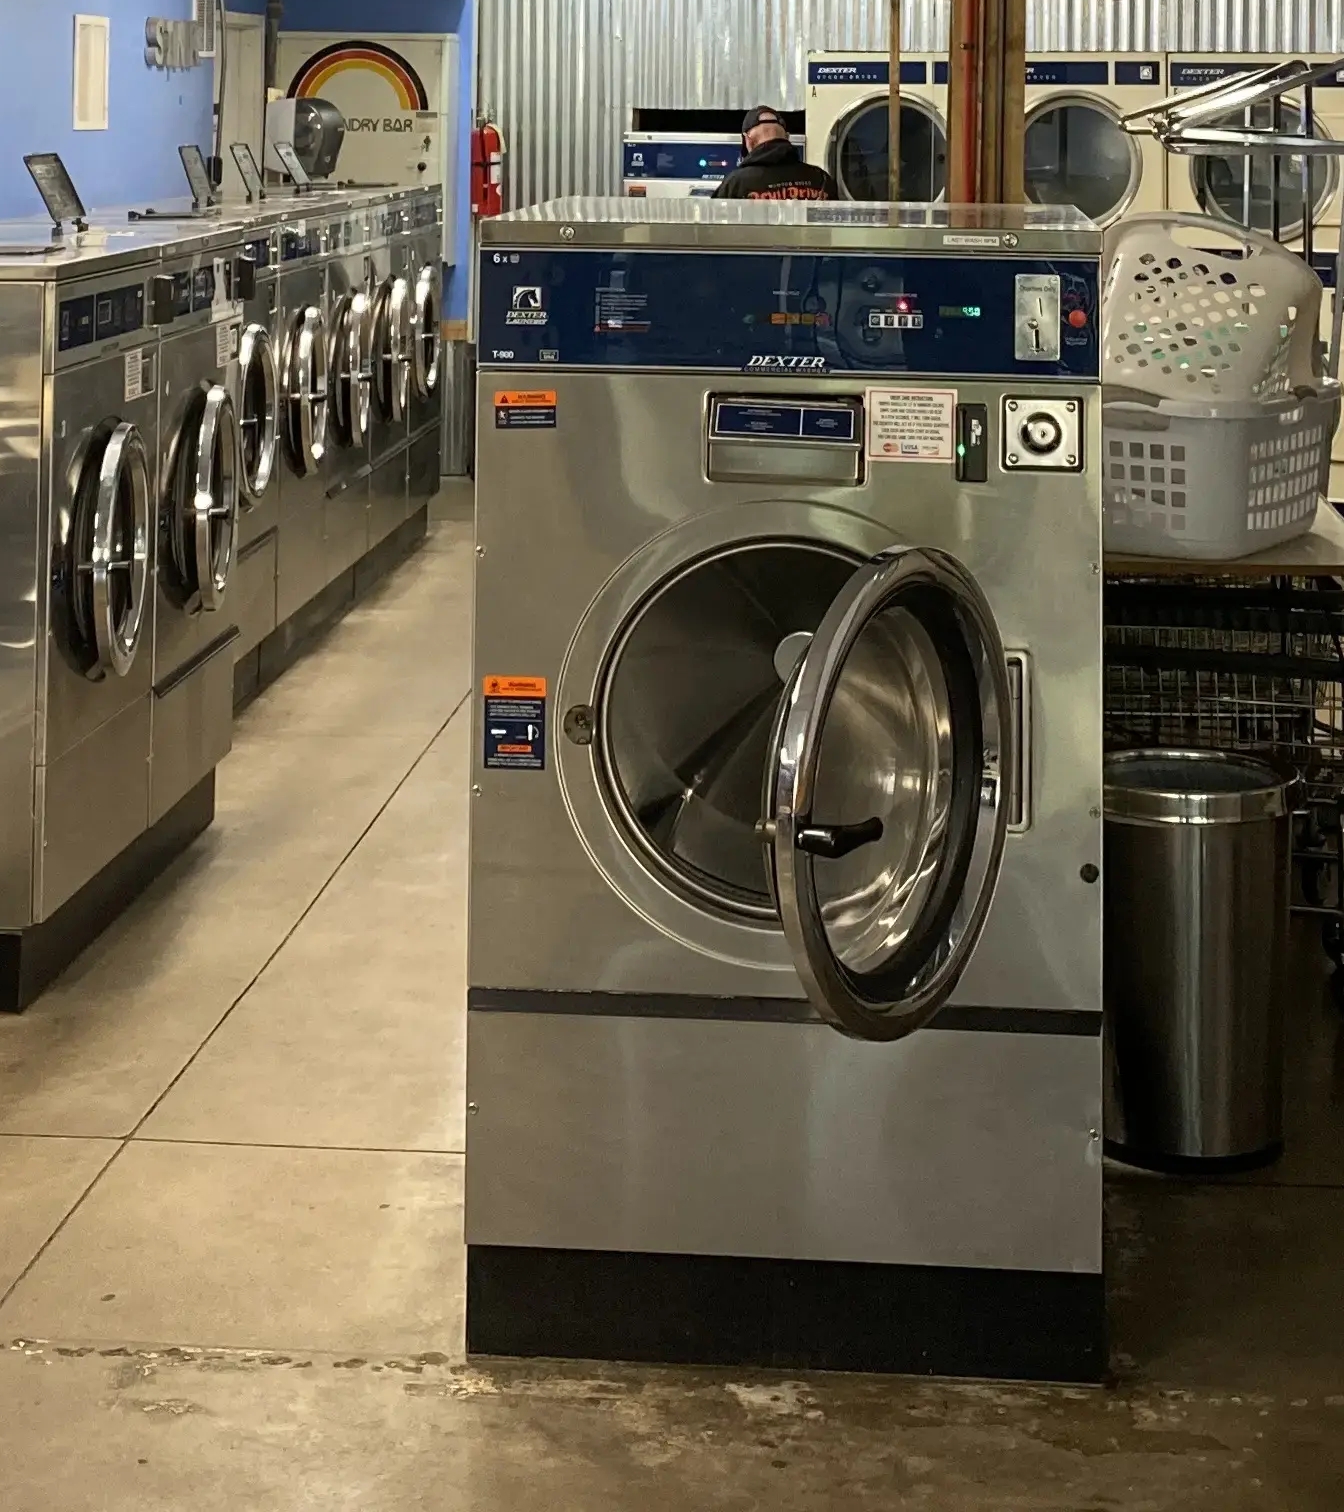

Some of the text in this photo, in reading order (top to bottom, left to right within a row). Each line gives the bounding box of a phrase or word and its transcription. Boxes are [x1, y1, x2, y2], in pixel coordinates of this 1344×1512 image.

[382, 118, 413, 133] BAR
[493, 253, 501, 264] 6
[506, 310, 548, 319] DEXTER
[747, 355, 826, 368] DEXTER
